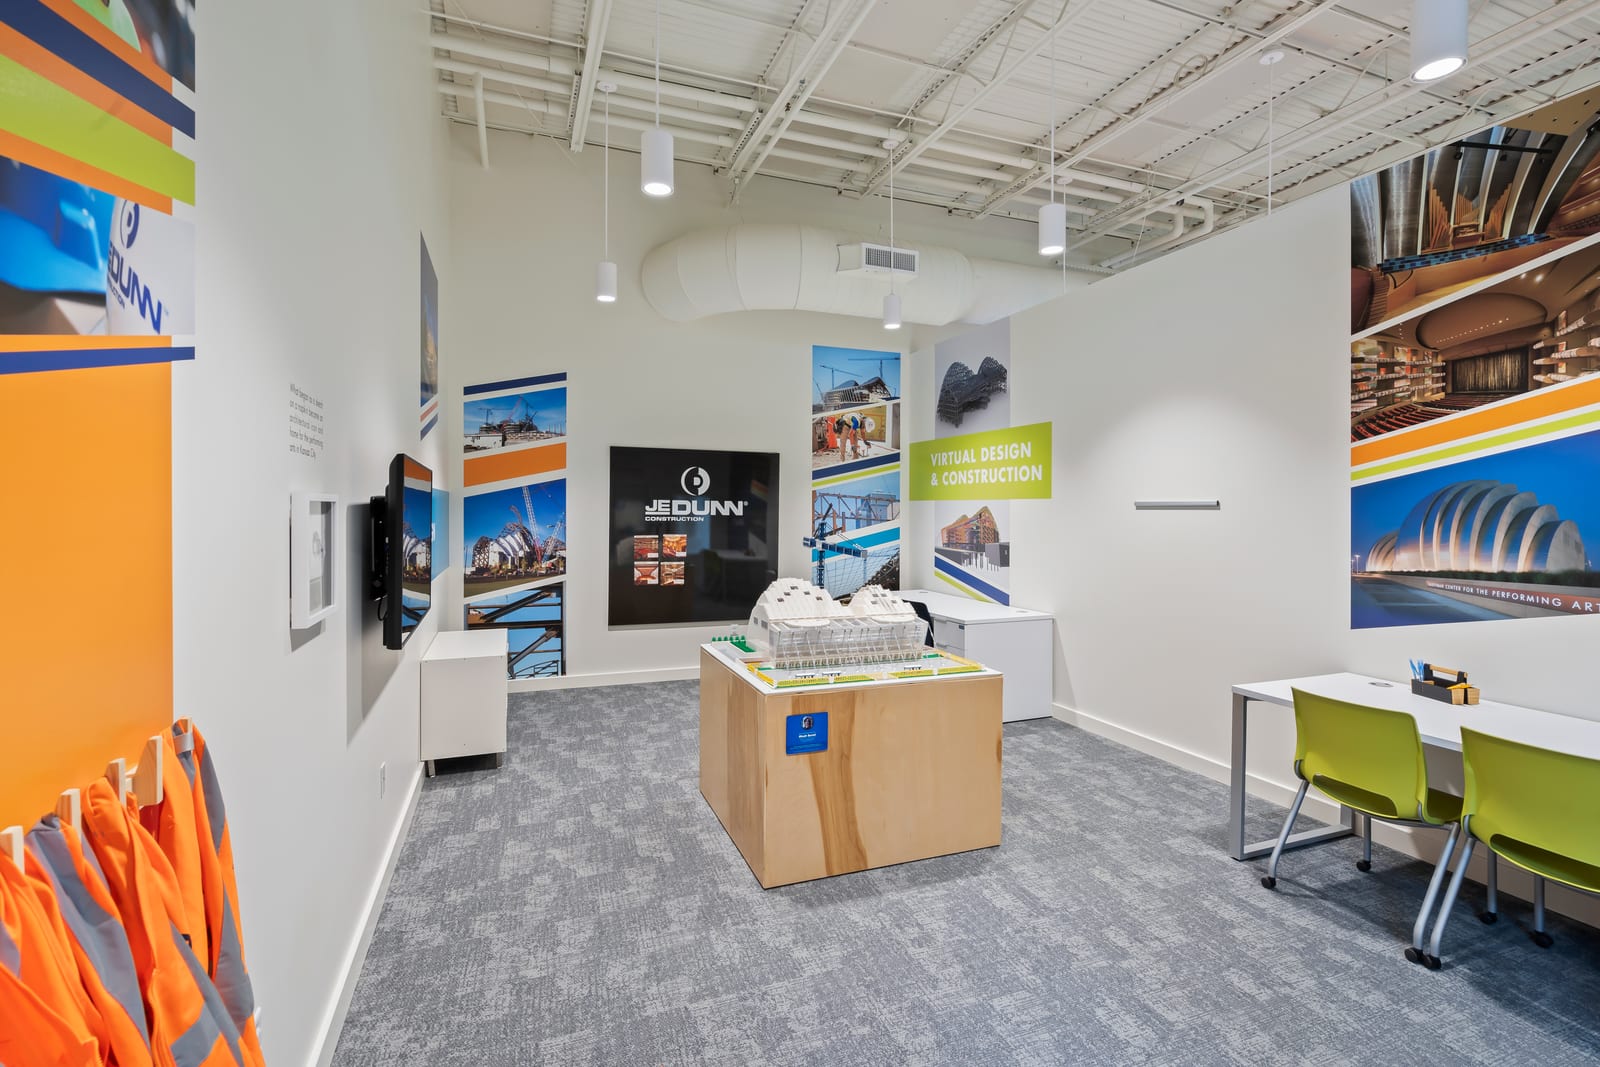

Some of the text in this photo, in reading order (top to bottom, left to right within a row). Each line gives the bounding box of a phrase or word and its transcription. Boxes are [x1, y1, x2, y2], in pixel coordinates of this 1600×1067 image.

[930, 441, 1032, 467] VIRTUAL DESIGN
[931, 464, 1043, 486] & CONSTRUCTION
[1477, 587, 1488, 596] THE
[1492, 590, 1562, 607] PERFORMING
